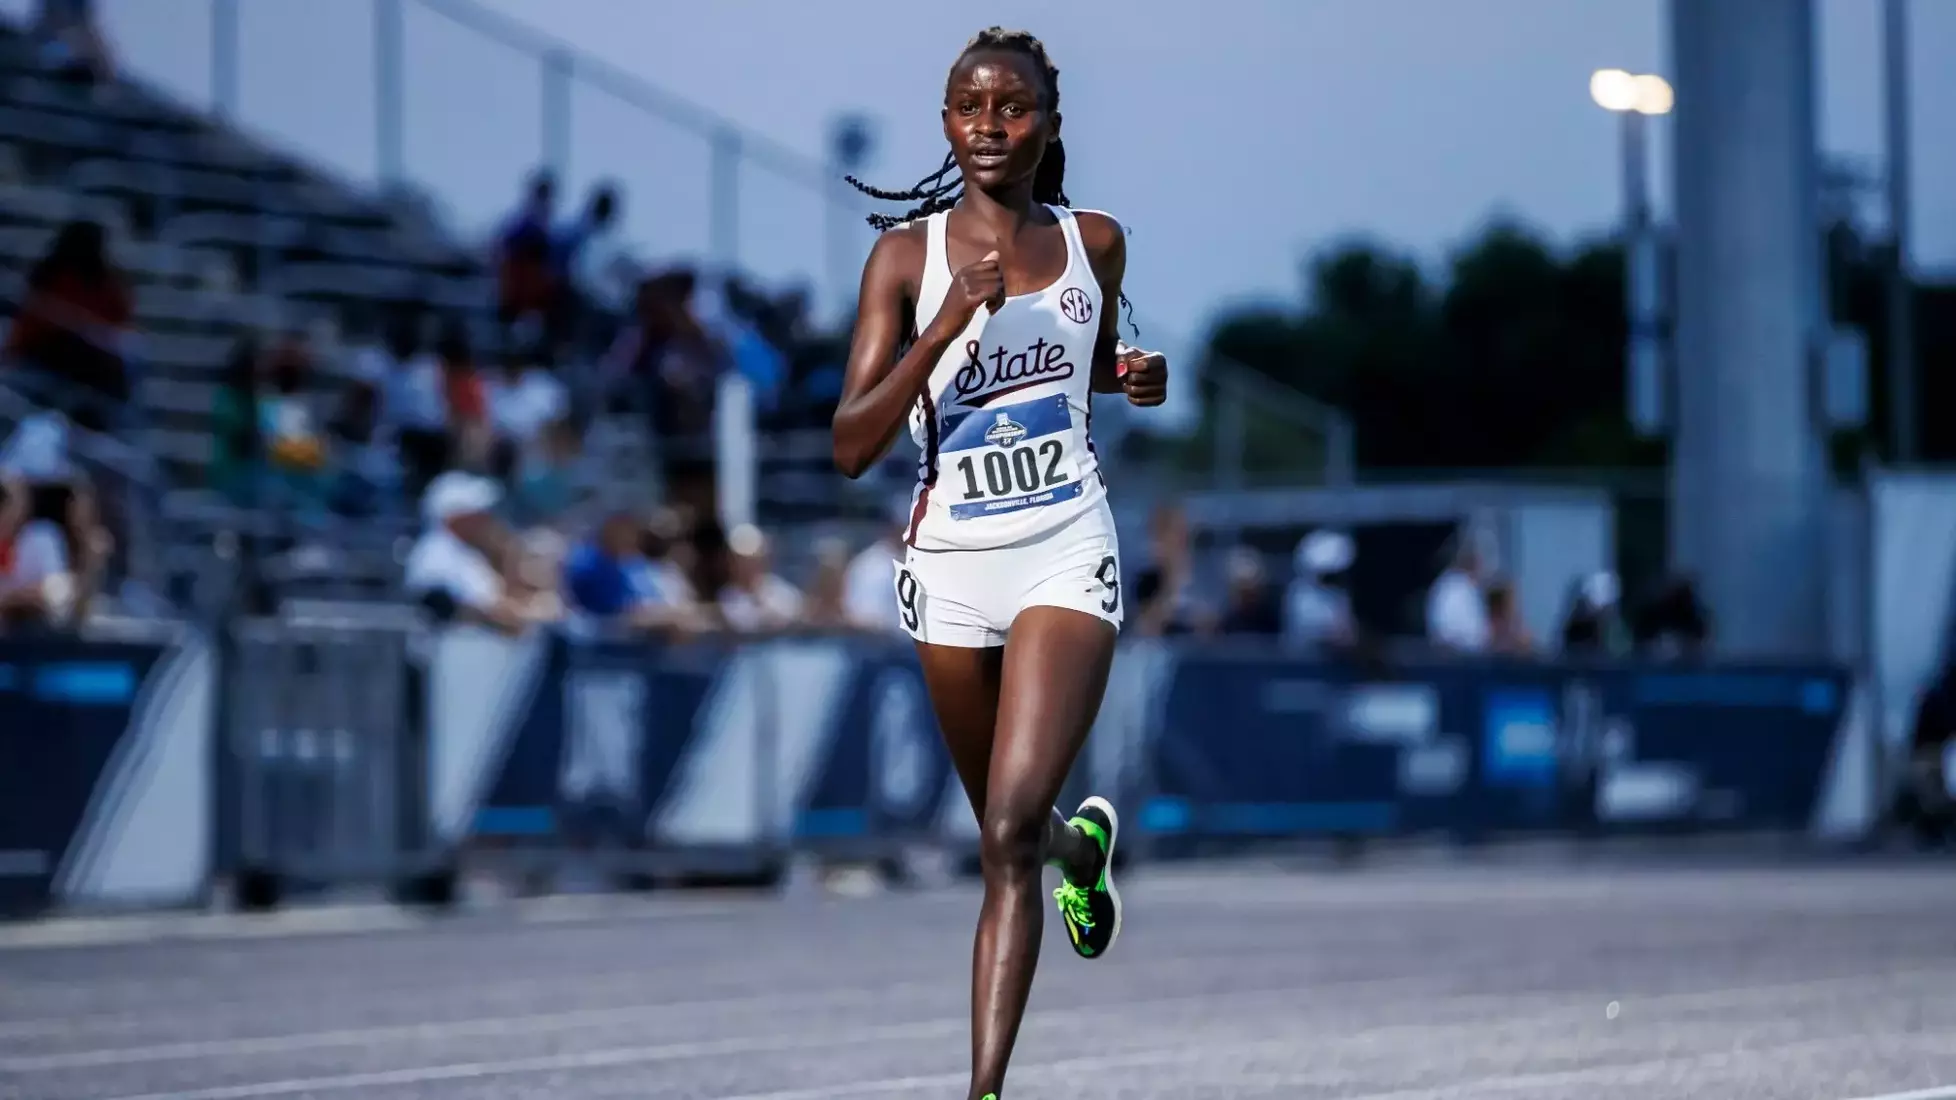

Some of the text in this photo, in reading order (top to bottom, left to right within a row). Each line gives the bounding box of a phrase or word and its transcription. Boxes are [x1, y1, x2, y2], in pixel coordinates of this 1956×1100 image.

[1060, 288, 1093, 324] SEC
[954, 337, 1074, 400] State
[957, 440, 1069, 499] 1002
[898, 569, 918, 632] 9
[1095, 556, 1118, 613] 9
